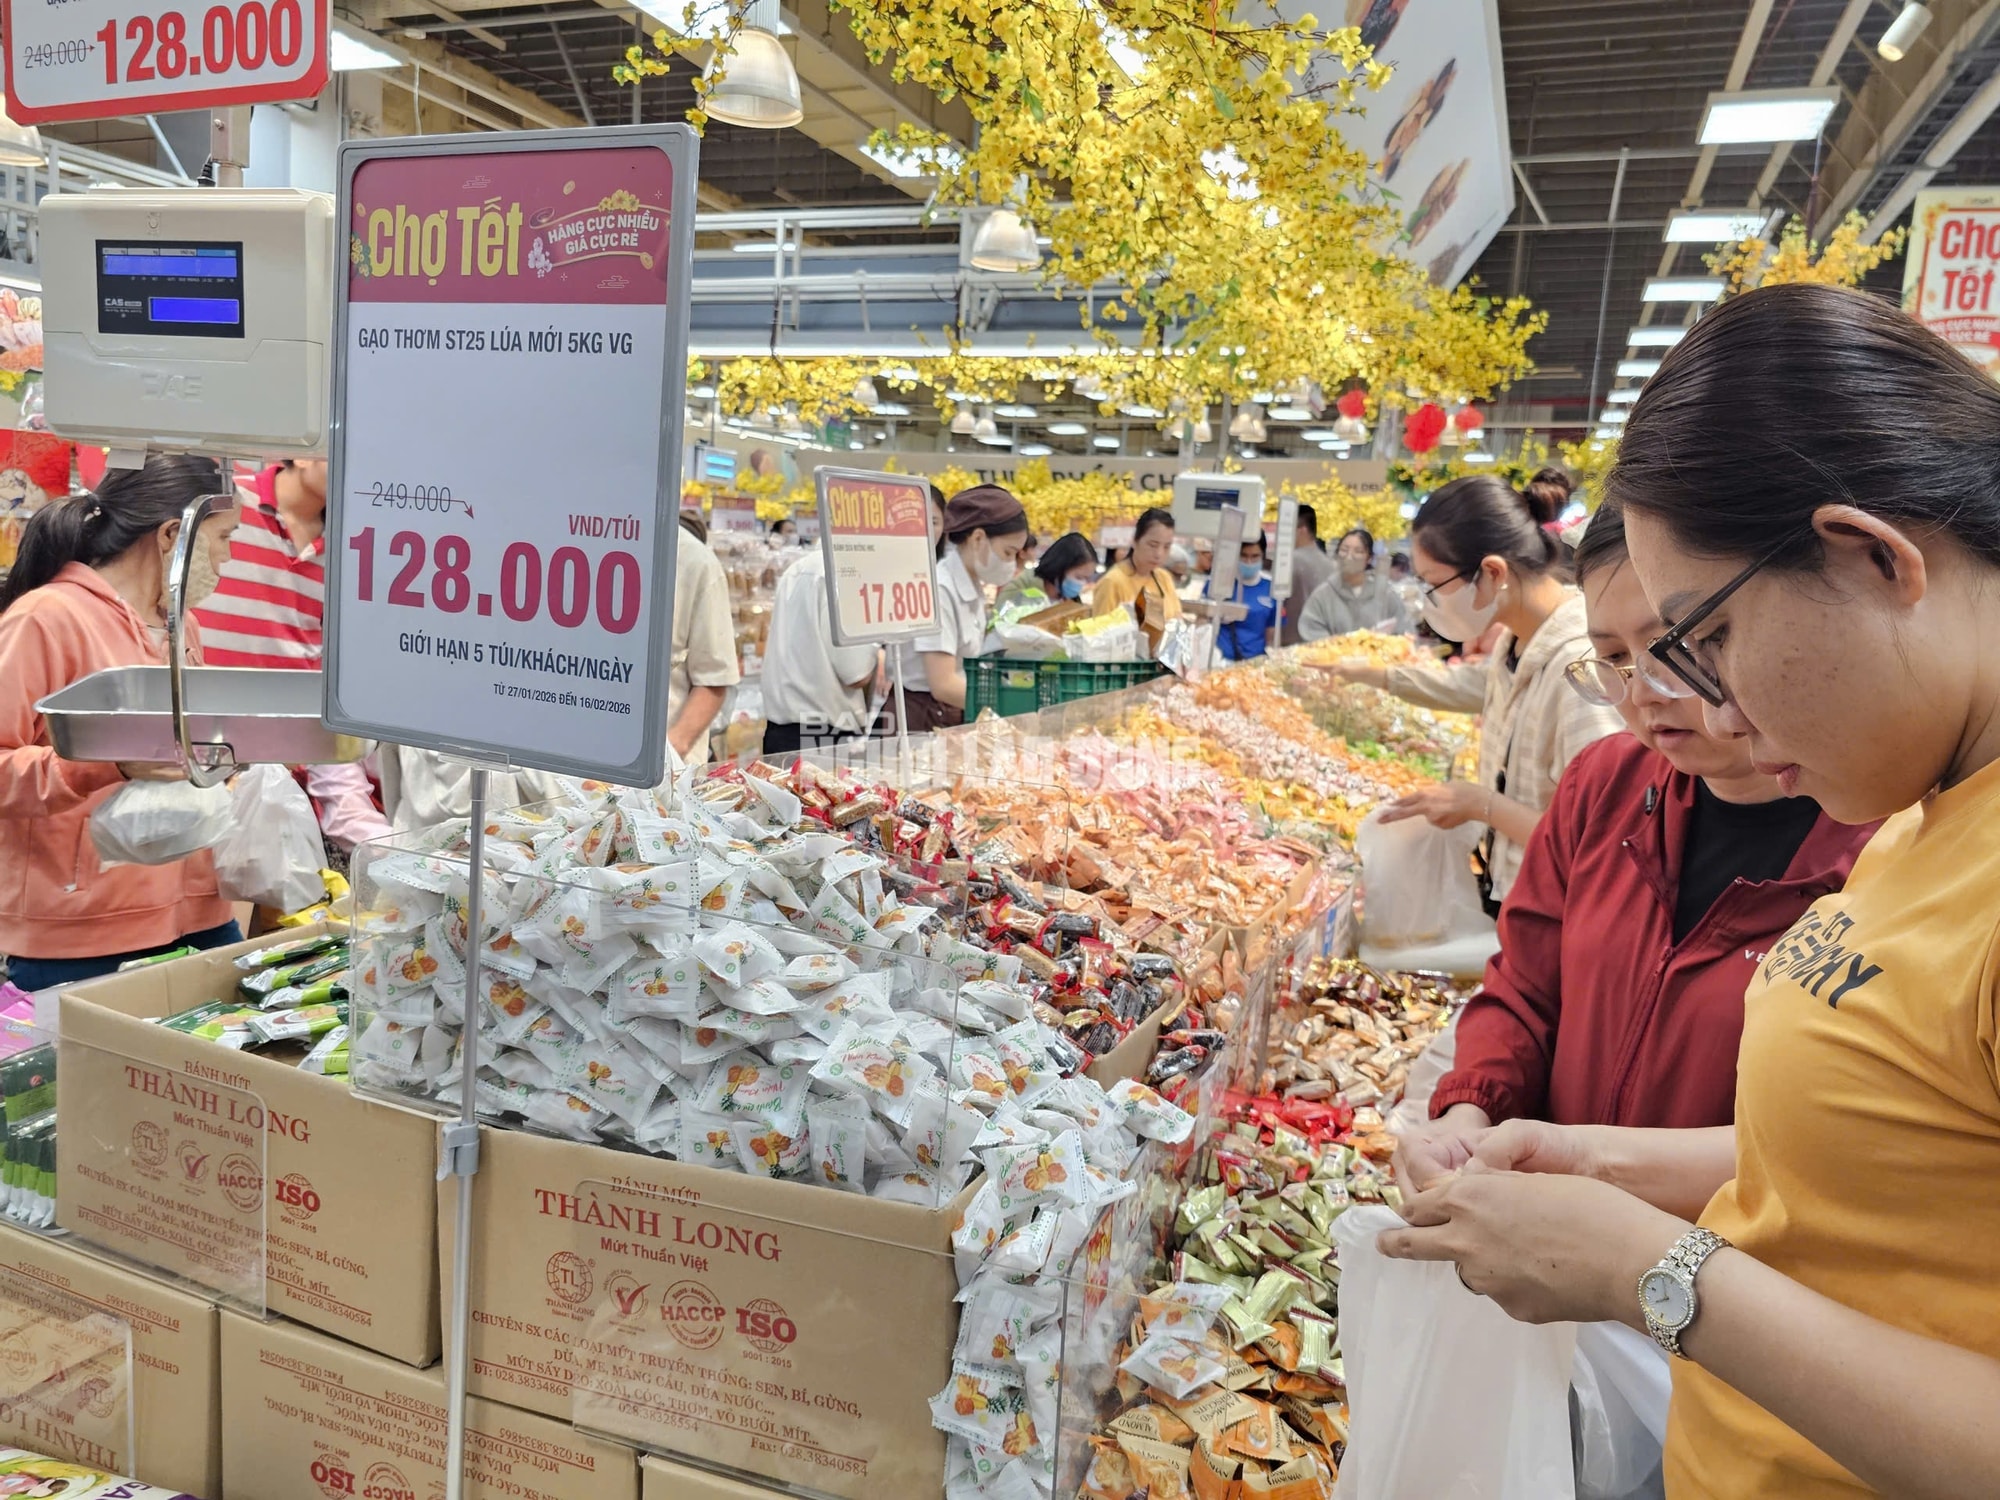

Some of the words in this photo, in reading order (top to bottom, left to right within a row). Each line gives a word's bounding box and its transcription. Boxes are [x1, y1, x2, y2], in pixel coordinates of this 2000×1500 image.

[25, 39, 87, 69] 249.000
[97, 0, 302, 84] 128.000
[368, 204, 448, 286] Chợ
[456, 196, 524, 277] Tết
[548, 219, 585, 244] HÀNG
[586, 214, 616, 235] CỰC
[617, 209, 660, 232] NHIỀU
[565, 232, 588, 255] GIÁ
[589, 231, 619, 253] CỰC
[620, 227, 639, 248] RẺ
[1942, 263, 1996, 311] Tết
[358, 327, 389, 354] GẠO
[394, 327, 441, 350] THƠM
[445, 329, 485, 351] ST25
[490, 325, 523, 352] LÚA
[527, 325, 563, 353] MỚI
[568, 332, 603, 354] 5KG
[609, 332, 633, 354] VG
[371, 480, 452, 514] 249.000
[829, 485, 861, 534] Chợ
[861, 486, 886, 529] Tết
[568, 513, 641, 541] VND/TÚI
[349, 526, 642, 634] 128.000
[860, 580, 931, 624] 17.800
[399, 629, 431, 655] GIỚI
[436, 637, 469, 665] HẠN
[474, 643, 484, 664] 5
[488, 641, 634, 684] TÚI/KHÁCH/NGÀY
[493, 682, 507, 696] TỪ
[507, 686, 558, 705] 27/01/2026
[558, 689, 578, 707] ĐẾN
[579, 697, 631, 716] 16/02/2026
[184, 1060, 220, 1081] BÁNH
[222, 1070, 251, 1091] MỨT
[125, 1064, 220, 1116] THÀNH
[228, 1098, 312, 1144] LONG
[142, 1135, 158, 1153] TL
[173, 1110, 196, 1129] Mứt
[232, 1128, 255, 1149] Việt
[275, 1179, 321, 1213] ISO
[611, 1176, 661, 1199] BÁNH
[534, 1188, 662, 1238] THÀNH
[672, 1214, 783, 1263] LONG
[600, 1236, 628, 1255] Mứt
[680, 1252, 709, 1273] Việt
[560, 1267, 580, 1288] TL
[660, 1304, 727, 1323] HACCP
[735, 1307, 798, 1345] ISO
[472, 1309, 524, 1332] CHUYÊN
[525, 1322, 542, 1338] SX
[544, 1326, 570, 1344] CÁC
[573, 1335, 604, 1356] LOẠI
[606, 1344, 636, 1362] MỨT
[697, 1366, 753, 1390] THỐNG:
[755, 1381, 788, 1401] SEN,
[791, 1387, 811, 1407] BÍ,
[813, 1392, 863, 1419] GỪNG,
[506, 1351, 534, 1371] MỨT
[536, 1358, 562, 1378] SẤY
[742, 1350, 765, 1362] 9001
[770, 1356, 792, 1369] 2015
[323, 1369, 345, 1386] Fax:
[473, 1362, 493, 1378] ĐT:
[494, 1368, 569, 1398] 028.38334865
[384, 1389, 448, 1420] 28.38328554
[35, 1417, 120, 1474] THÀNH
[499, 1427, 573, 1460] 028.38334865
[506, 1445, 531, 1463] SẤY
[574, 1452, 596, 1468] ĐT:
[750, 1435, 777, 1454] Fax:
[779, 1446, 869, 1478] 028.38340584
[310, 1460, 356, 1495] ISO
[531, 1456, 560, 1475] MỨT
[496, 1478, 521, 1498] CÁC
